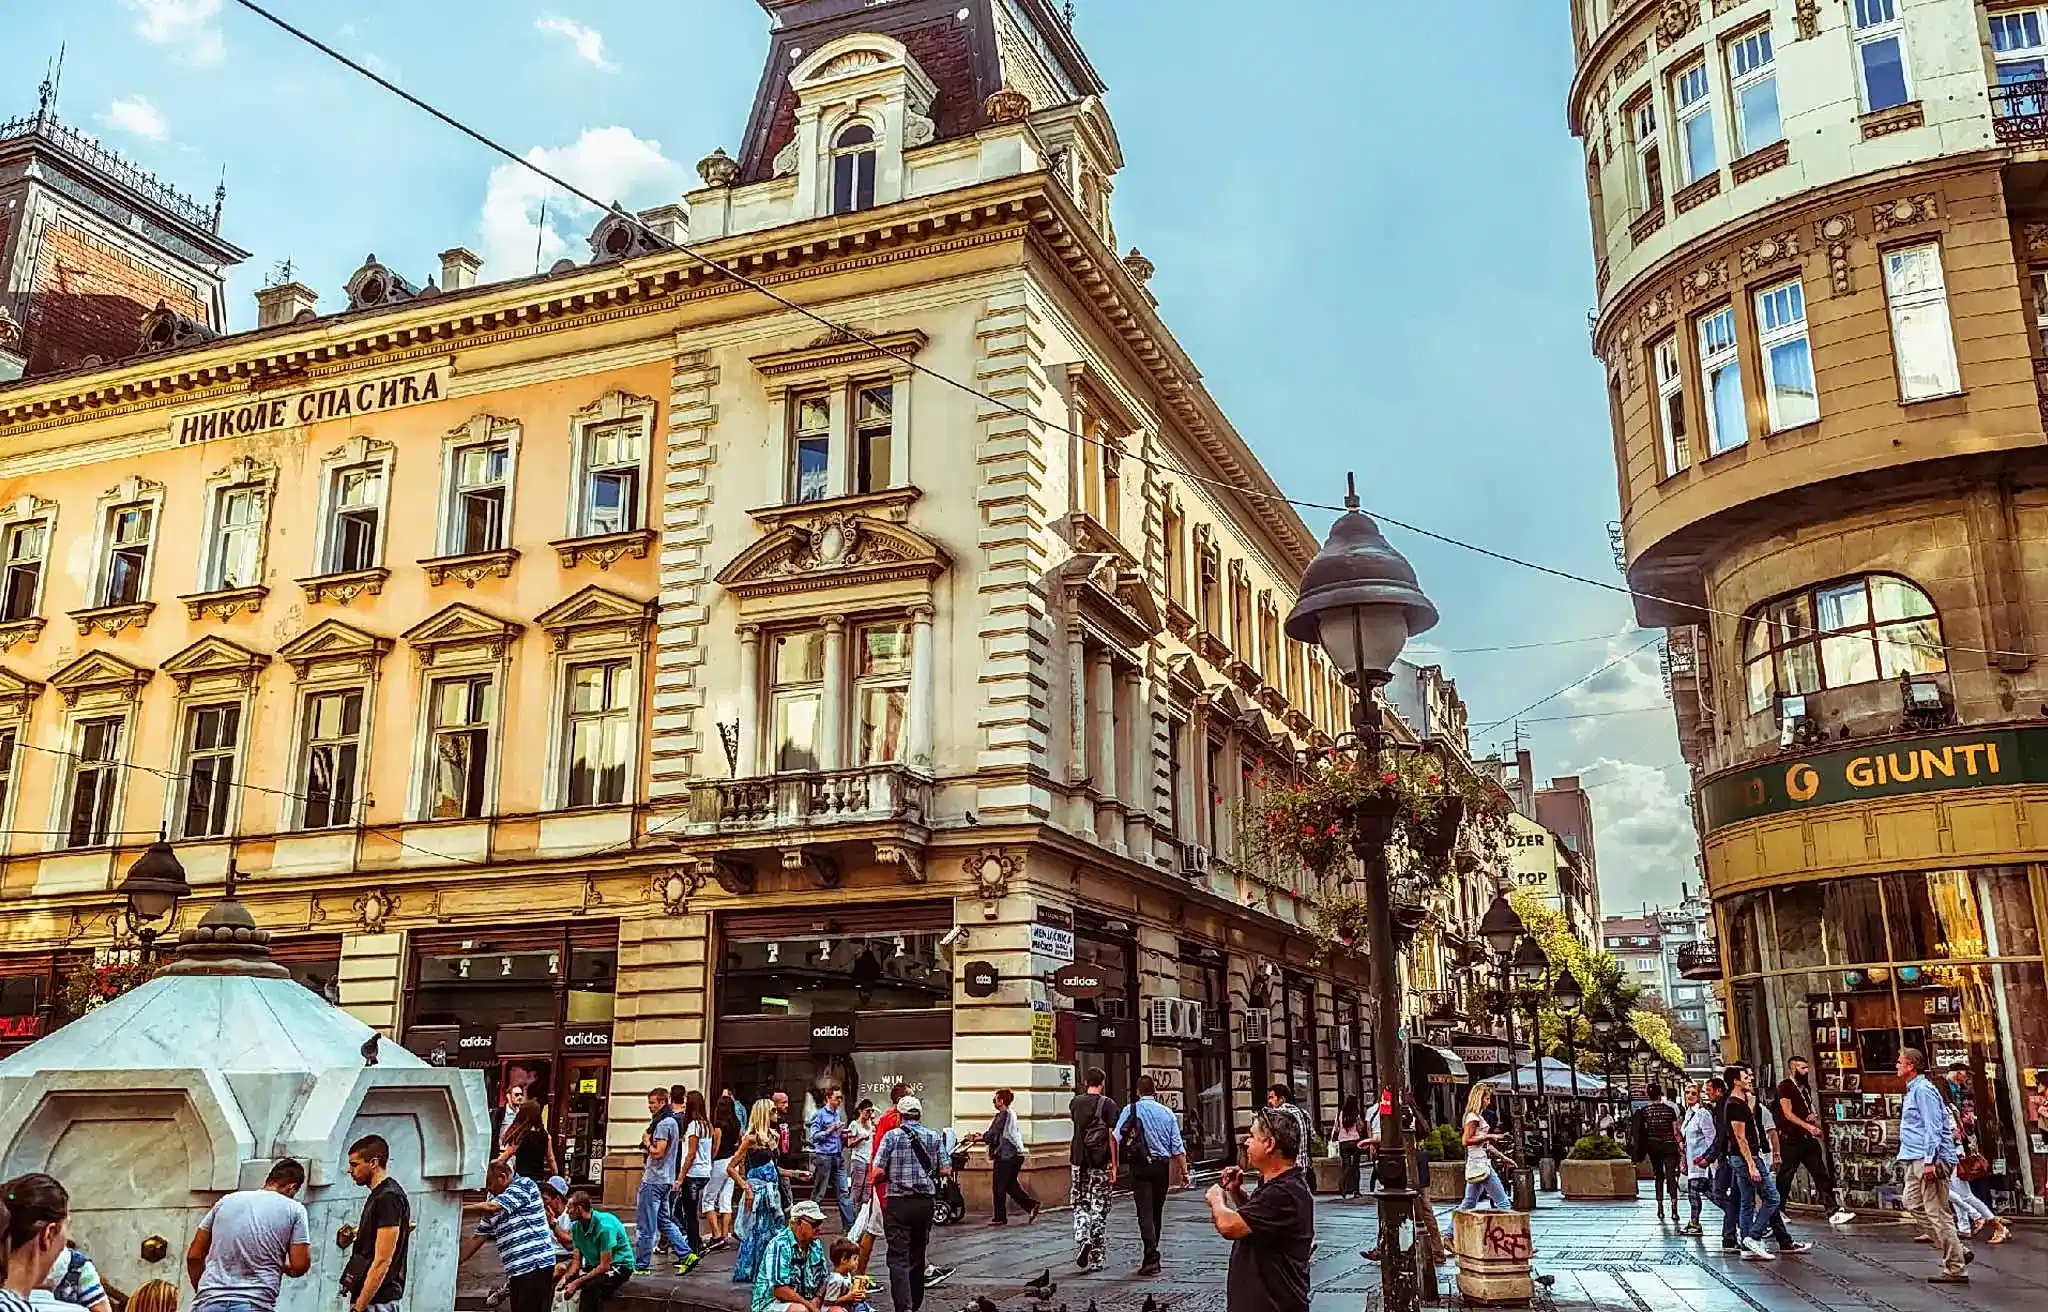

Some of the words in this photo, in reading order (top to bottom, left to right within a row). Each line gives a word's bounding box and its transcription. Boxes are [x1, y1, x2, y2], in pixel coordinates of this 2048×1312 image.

[180, 399, 287, 445] НИКОЛЕ
[297, 372, 439, 422] СПАСИЋА
[1846, 743, 1999, 787] GIUNTI
[1063, 976, 1098, 986] adidas
[813, 1025, 849, 1037] adidas
[460, 1036, 492, 1048] adidas
[565, 1032, 608, 1046] adidas
[881, 1074, 904, 1085] WIN
[860, 1082, 925, 1093] EVERYNG
